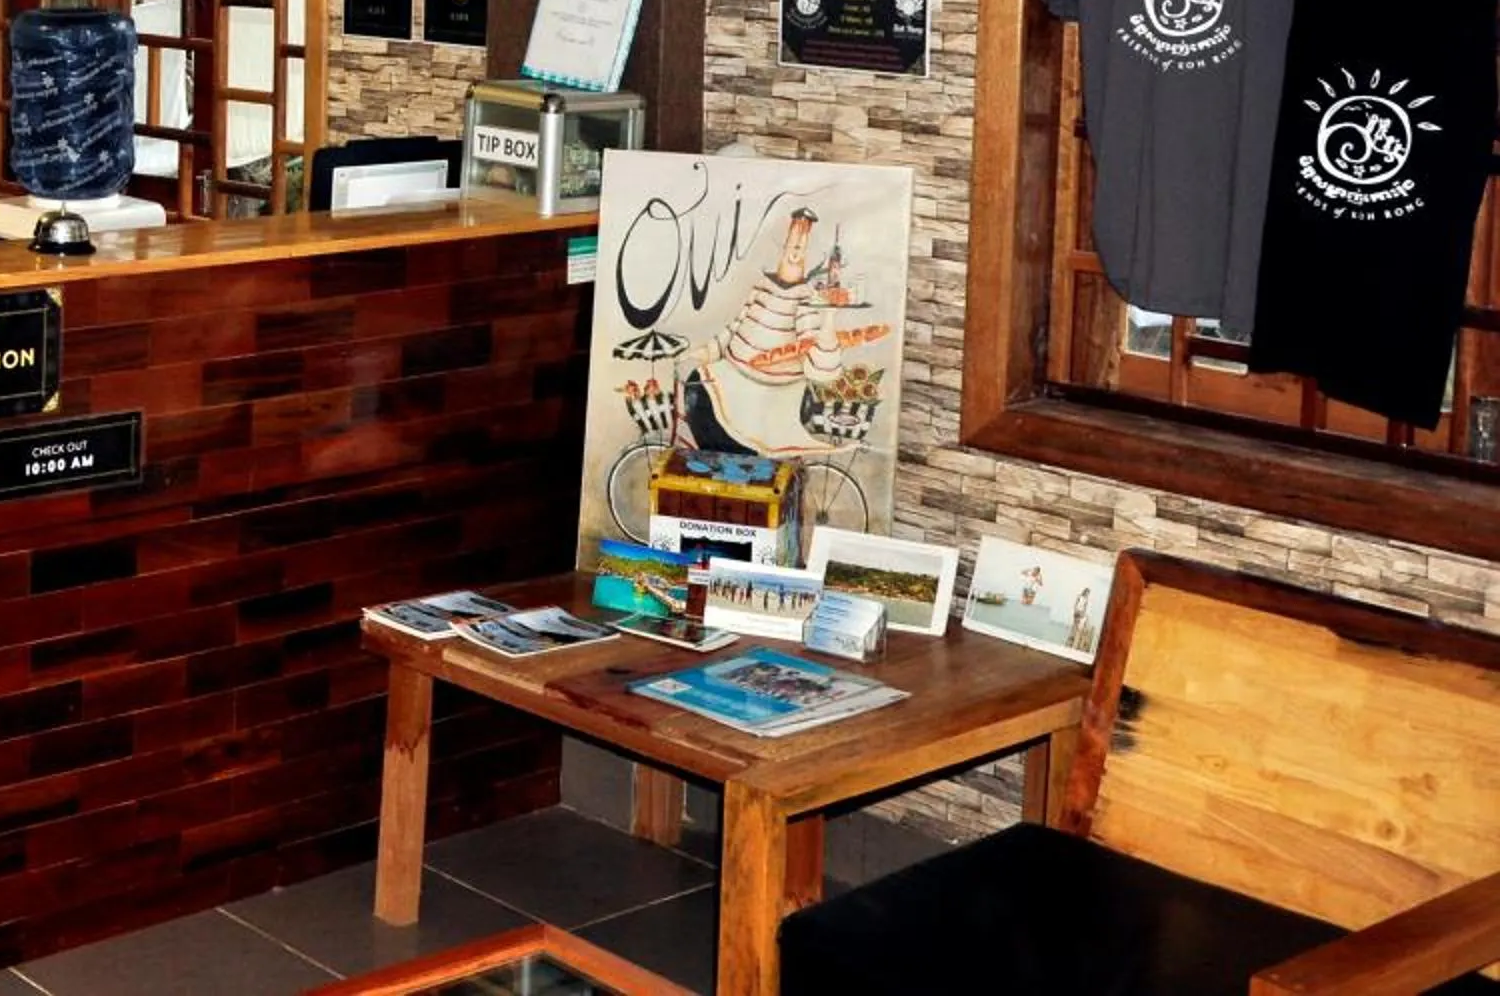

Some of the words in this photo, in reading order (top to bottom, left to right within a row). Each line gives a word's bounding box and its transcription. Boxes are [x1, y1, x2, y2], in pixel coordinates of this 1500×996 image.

[477, 133, 501, 150] TIP
[503, 137, 536, 161] BOX
[1383, 197, 1425, 220] RONG
[615, 161, 792, 331] Oui
[31, 444, 65, 459] CHECK
[66, 440, 88, 453] OUT
[25, 459, 66, 477] 10:00
[71, 454, 94, 469] AM
[680, 521, 733, 536] DONATION
[735, 527, 757, 538] BOX
